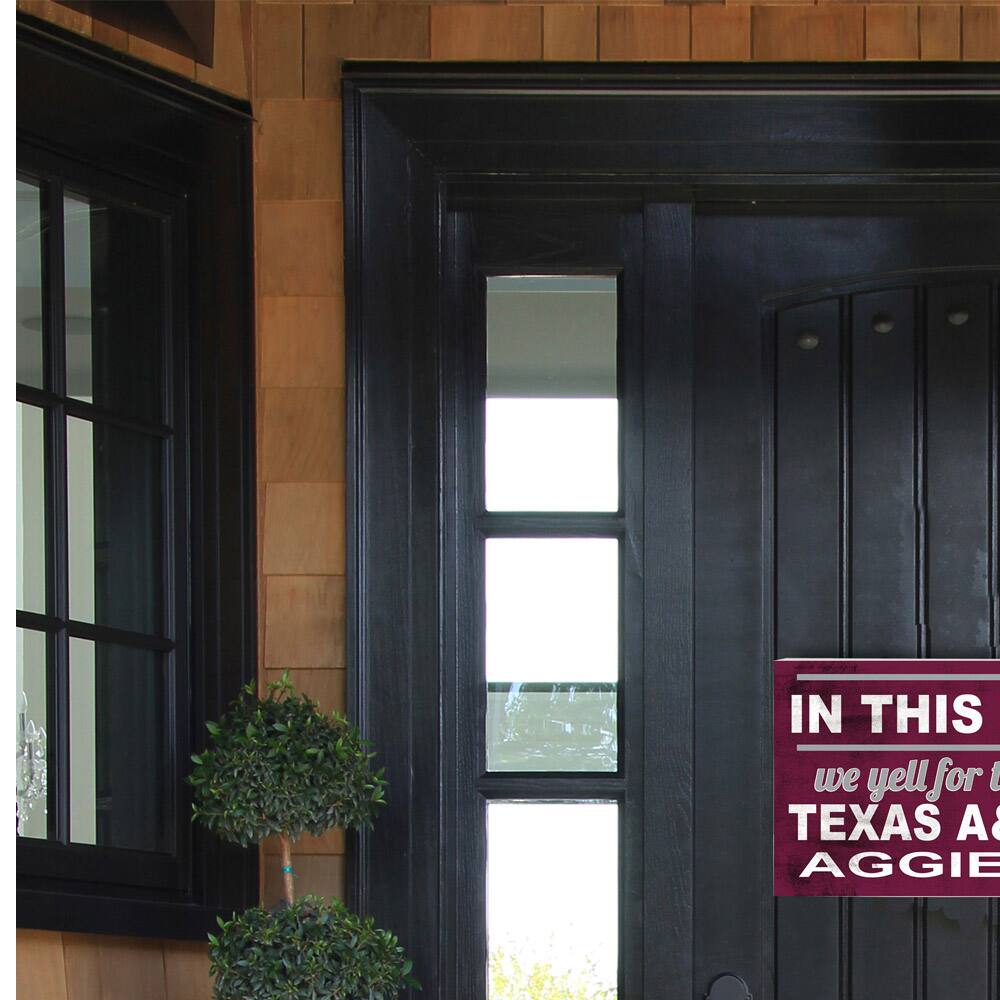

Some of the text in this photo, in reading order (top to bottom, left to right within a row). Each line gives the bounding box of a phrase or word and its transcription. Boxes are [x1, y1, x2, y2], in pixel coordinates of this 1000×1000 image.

[790, 694, 842, 734] IN
[860, 693, 983, 734] THIS
[813, 766, 861, 793] we
[866, 758, 929, 802] yell
[926, 756, 984, 802] for
[788, 803, 941, 842] TEXAS
